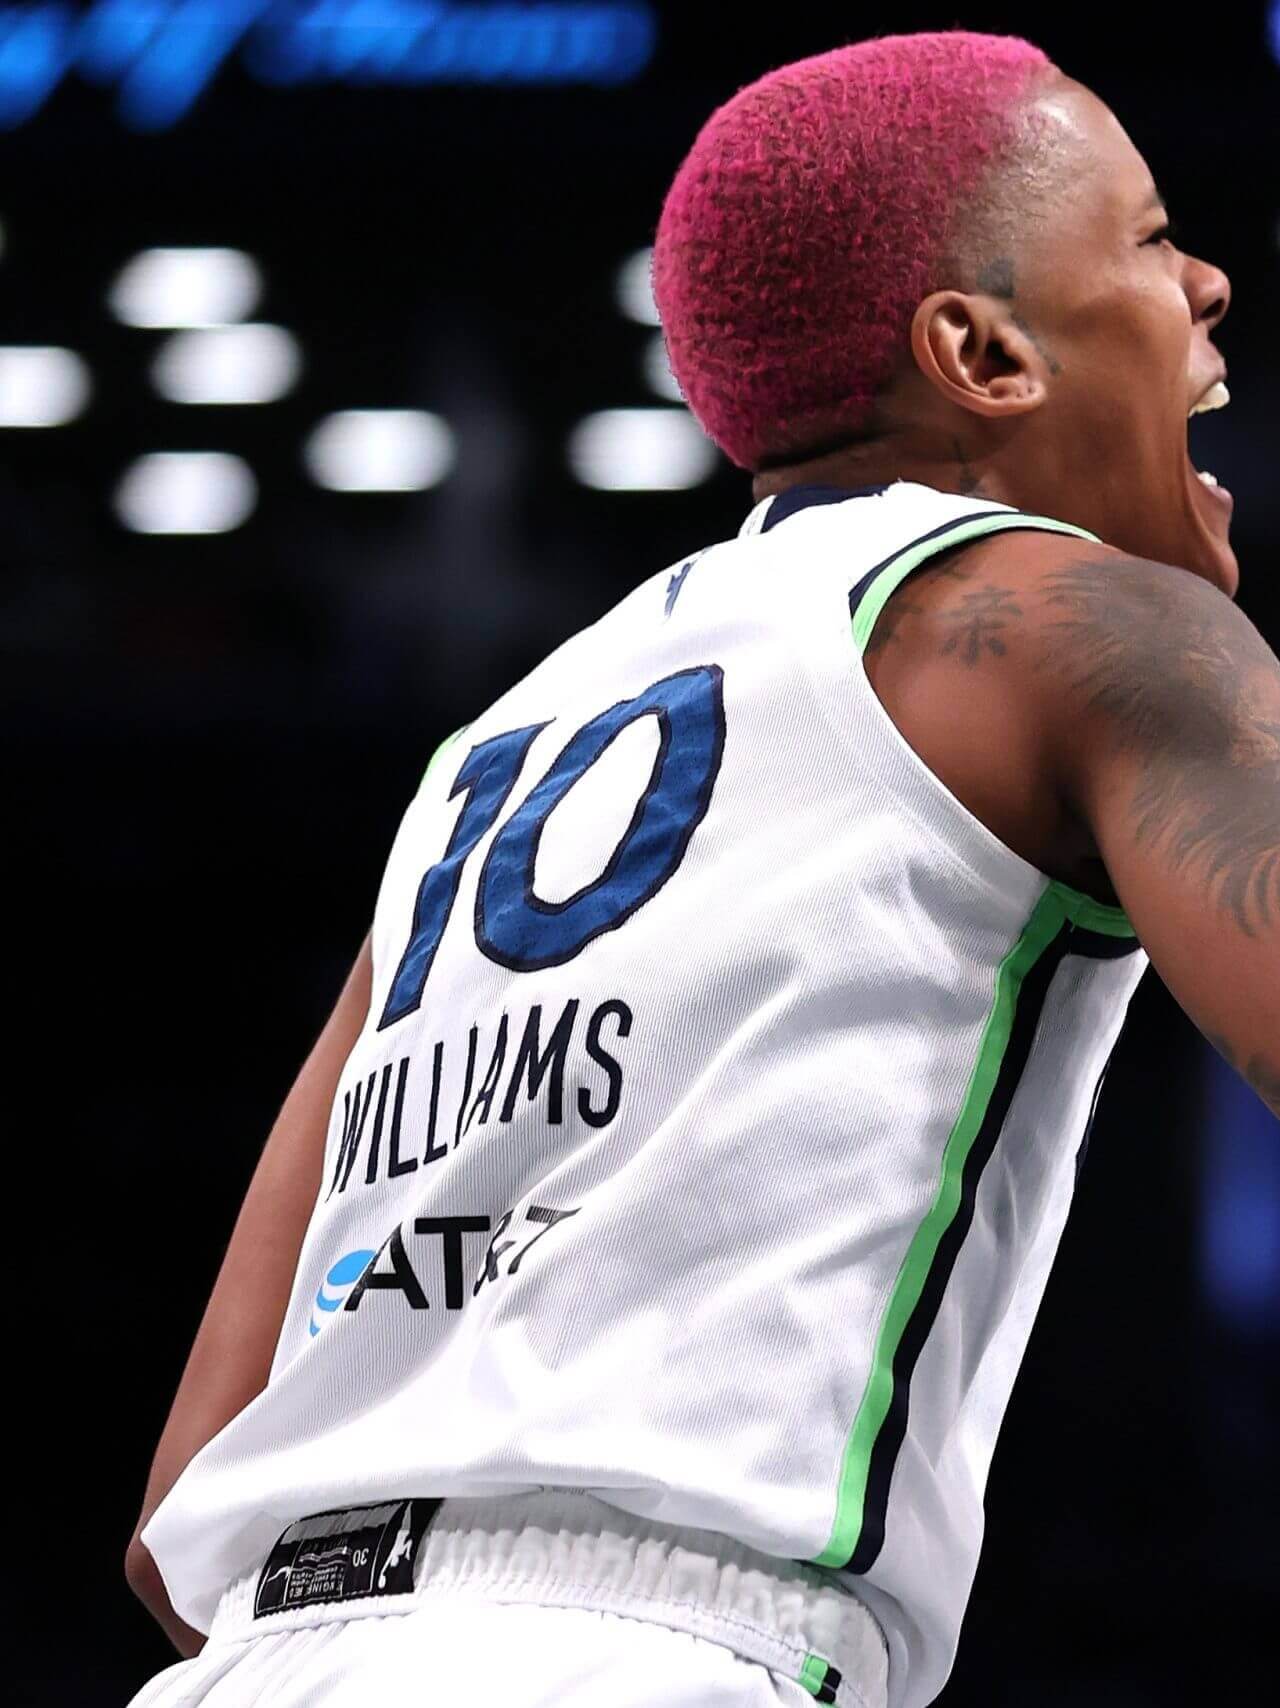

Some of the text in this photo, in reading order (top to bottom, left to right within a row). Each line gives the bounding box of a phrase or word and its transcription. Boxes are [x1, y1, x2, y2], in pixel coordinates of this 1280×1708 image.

[377, 664, 727, 1032] 10
[325, 997, 633, 1202] WILLIAMS
[352, 1547, 370, 1568] 30
